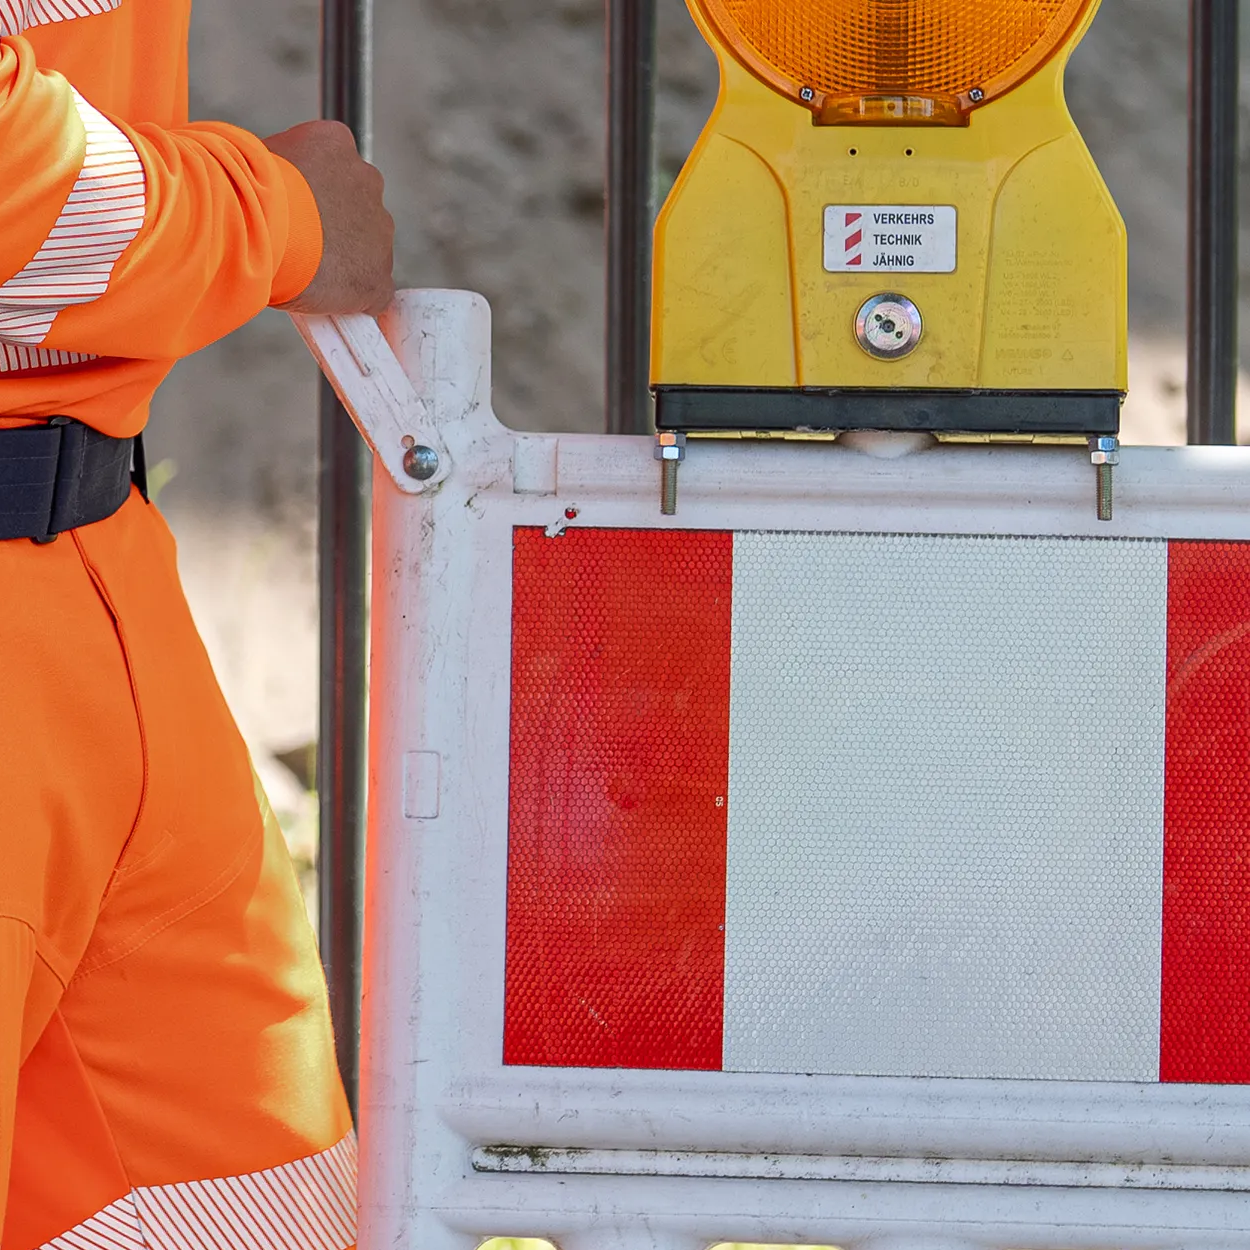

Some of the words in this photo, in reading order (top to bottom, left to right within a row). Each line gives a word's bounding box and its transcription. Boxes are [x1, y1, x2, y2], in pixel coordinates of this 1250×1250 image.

[873, 213, 935, 225] VERKEHRS
[873, 234, 922, 246] TECHNIK
[872, 252, 915, 267] JÄHNIG
